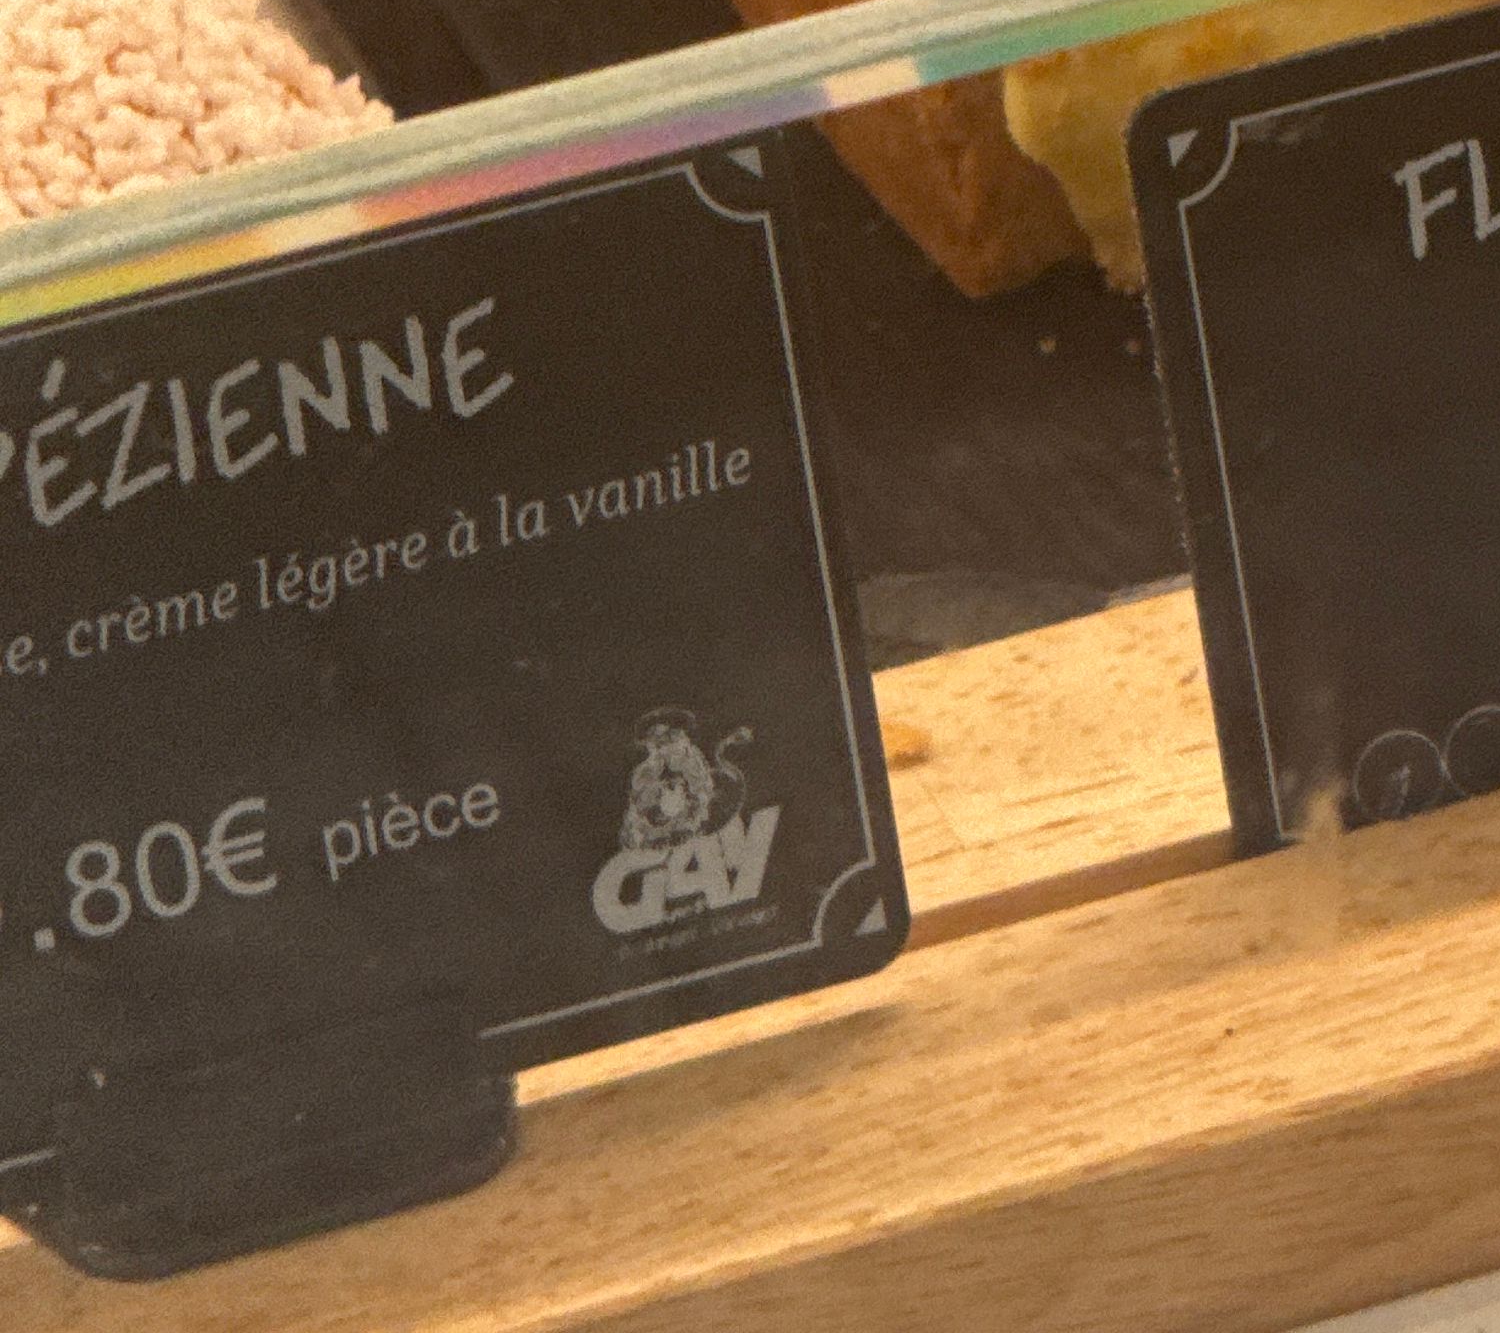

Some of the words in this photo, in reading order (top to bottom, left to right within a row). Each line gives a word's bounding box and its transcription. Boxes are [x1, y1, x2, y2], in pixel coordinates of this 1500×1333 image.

[0, 296, 515, 527] ÉZIENNE
[66, 580, 239, 659] crème
[254, 532, 428, 612] légère
[447, 509, 481, 559] à
[496, 493, 547, 548] la
[566, 439, 753, 528] vanille
[322, 782, 501, 882] pièce
